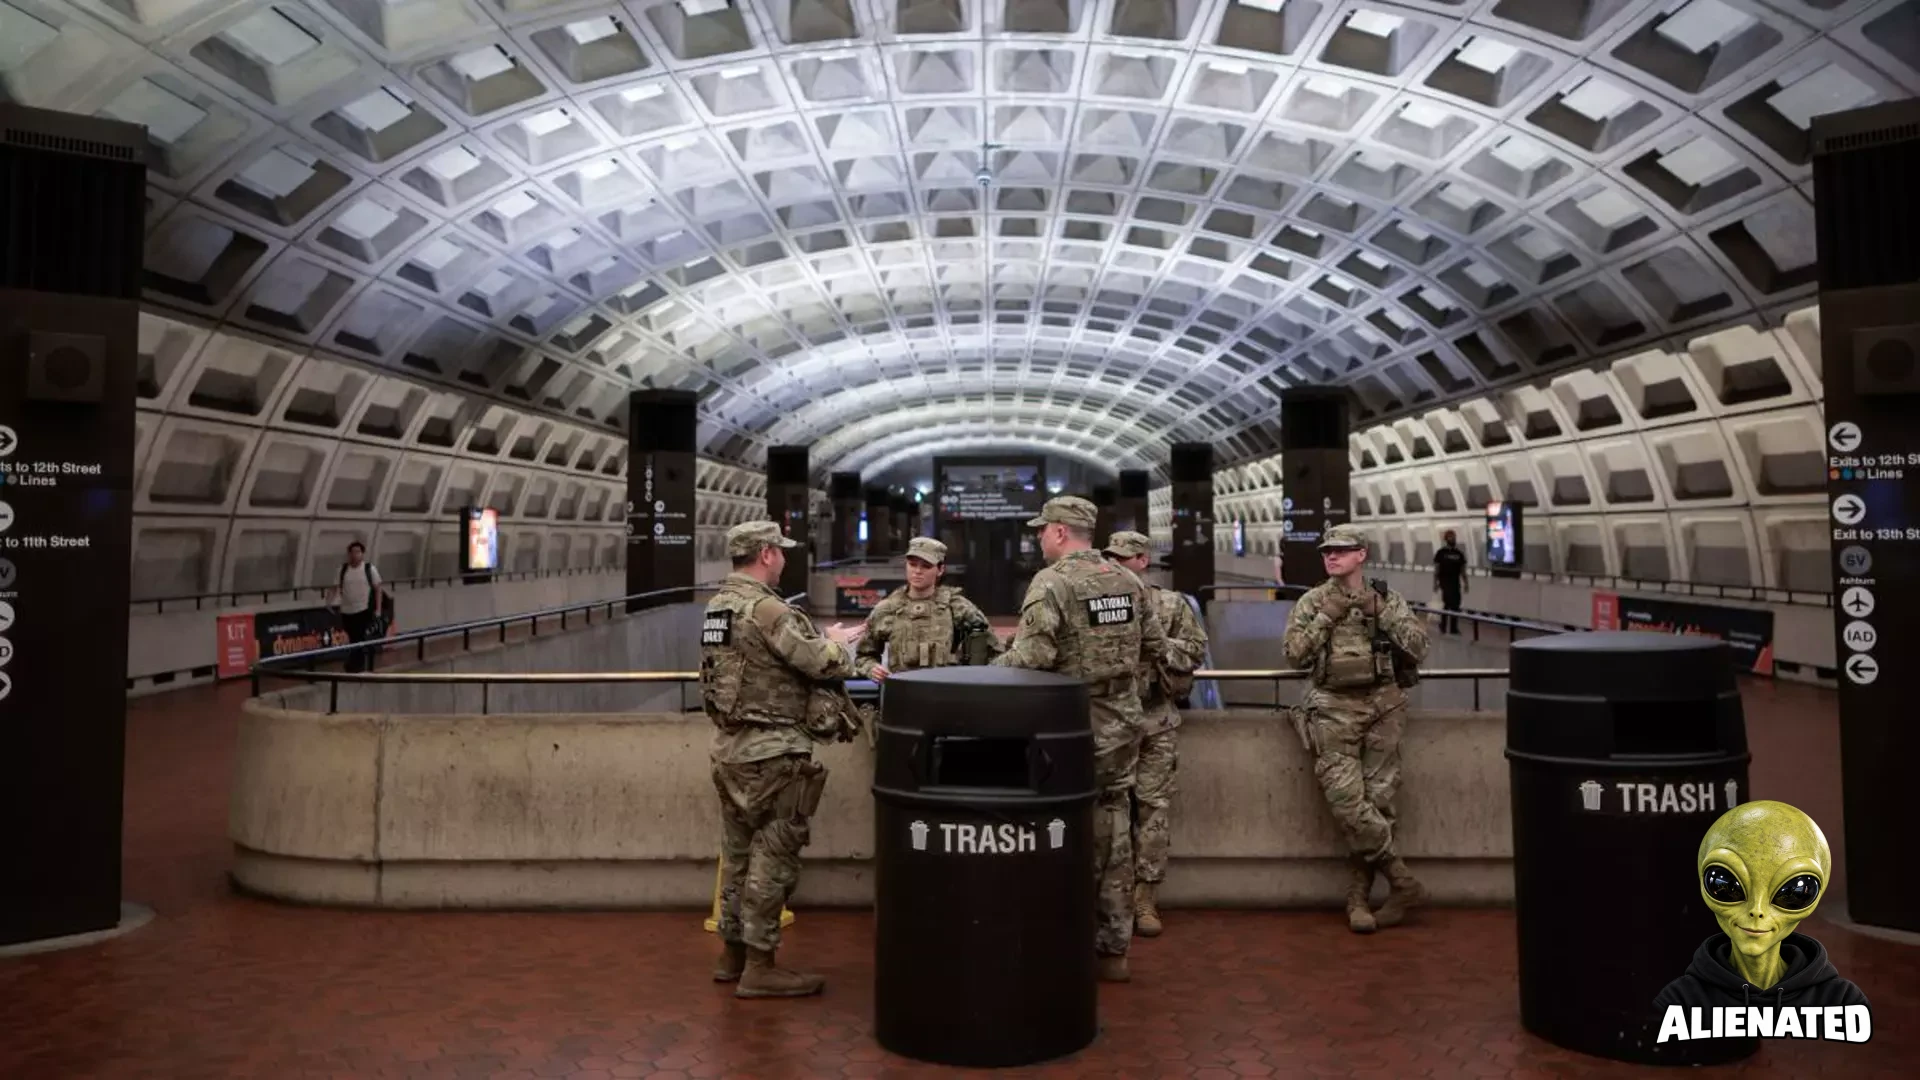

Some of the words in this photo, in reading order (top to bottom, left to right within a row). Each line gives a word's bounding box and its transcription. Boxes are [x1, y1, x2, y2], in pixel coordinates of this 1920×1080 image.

[1830, 456, 1860, 467] Exits
[1862, 455, 1876, 467] to
[1879, 453, 1905, 466] 12th
[16, 462, 29, 473] to
[33, 462, 60, 473] 12th
[62, 462, 101, 474] Street
[1867, 468, 1903, 479] Lines
[20, 474, 57, 486] Lines
[1833, 529, 1857, 540] Exit
[1860, 529, 1873, 540] to
[1876, 529, 1903, 540] 13th
[5, 537, 19, 547] to
[23, 536, 47, 548] 11th
[50, 535, 90, 548] Street
[1089, 596, 1131, 611] NATIONAL
[1098, 609, 1128, 623] GUARD
[1847, 629, 1874, 642] IAD
[1616, 782, 1715, 813] TRASH
[939, 823, 1036, 854] TRASH
